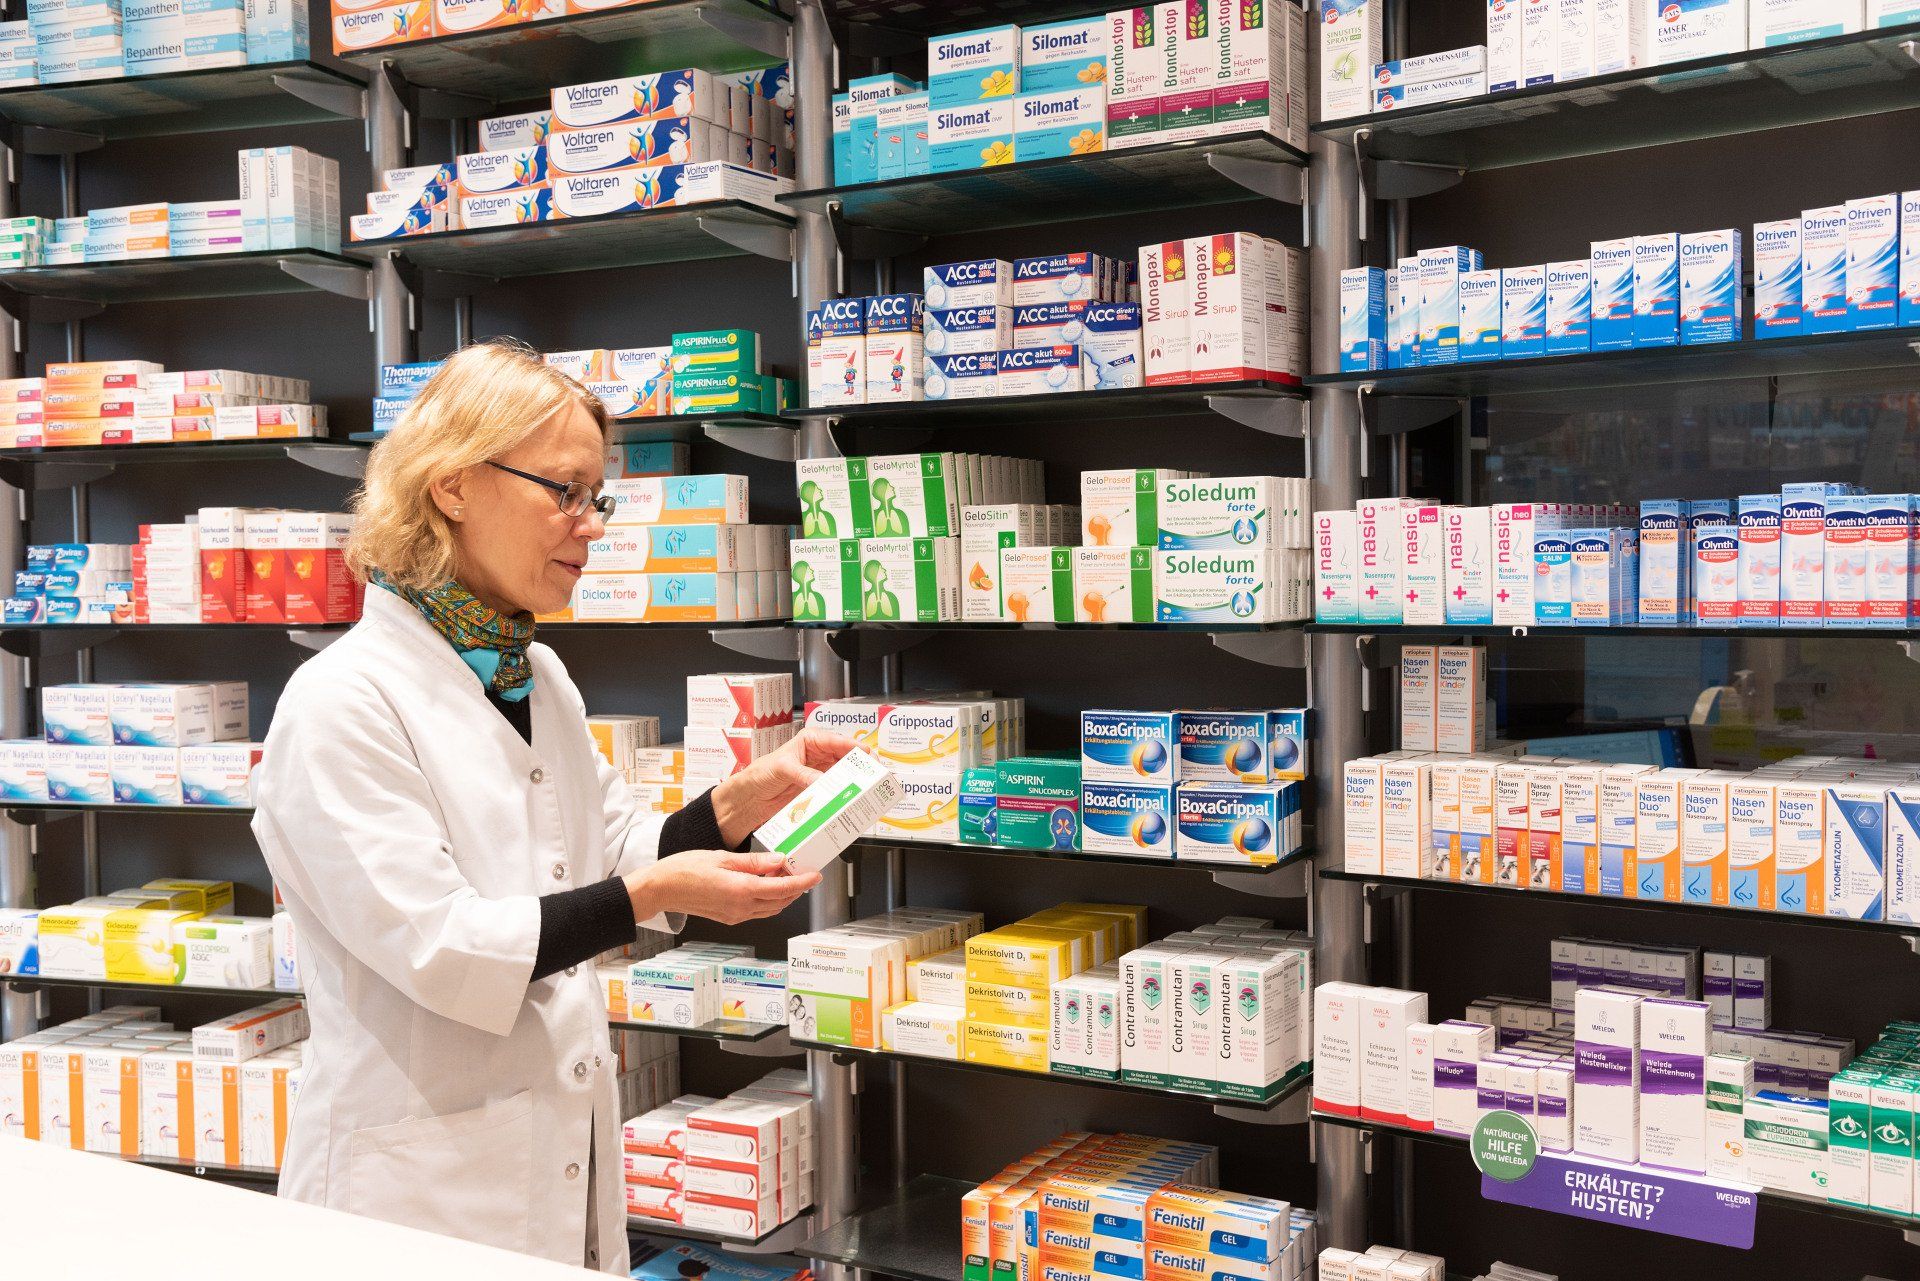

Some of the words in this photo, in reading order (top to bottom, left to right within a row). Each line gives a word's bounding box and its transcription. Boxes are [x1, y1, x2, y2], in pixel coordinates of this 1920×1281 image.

[125, 2, 179, 17] Bepanthen
[342, 12, 383, 27] Voltaren
[1490, 12, 1511, 23] EMSER
[1327, 27, 1362, 38] SINUSITIS
[1658, 25, 1687, 36] EMSER
[1032, 30, 1087, 51] Silomat
[1217, 0, 1232, 79] Bronchostop
[1327, 36, 1348, 44] SPRAY
[126, 44, 181, 59] Bepanthen
[938, 39, 991, 61] Silomat
[1164, 9, 1178, 87] Bronchostop
[1112, 18, 1125, 95] Bronchostop
[1233, 57, 1266, 67] Husten-
[1405, 58, 1425, 68] EMSER
[1428, 50, 1470, 63] NASENSALBE
[39, 62, 76, 72] Bepanthen
[1179, 66, 1211, 76] Husten-
[1233, 68, 1251, 76] saft
[1127, 74, 1157, 84] Husten-
[1180, 77, 1196, 85] saft
[566, 84, 618, 101] Voltaren
[1127, 84, 1142, 92] saft
[1024, 97, 1079, 117] Silomat
[937, 109, 990, 129] Silomat
[562, 131, 614, 148] Voltaren
[686, 163, 719, 176] Voltaren
[567, 176, 619, 192] Voltaren
[1849, 208, 1891, 220] Otriven
[90, 215, 127, 226] Bepanthen
[1756, 230, 1797, 241] Otriven
[1682, 242, 1728, 255] Otriven
[1593, 249, 1630, 260] Otriven
[1420, 257, 1454, 267] Otriven
[945, 264, 977, 281] ACC
[978, 262, 995, 270] akut
[1018, 261, 1048, 277] ACC
[1195, 245, 1210, 316] Monapax
[1147, 253, 1161, 322] Monapax
[822, 301, 857, 320] ACC
[868, 298, 905, 317] ACC
[1213, 305, 1237, 314] Sirup
[1086, 309, 1114, 323] ACC
[1165, 310, 1188, 319] Sirup
[822, 320, 859, 329] Kindersaft
[868, 317, 907, 326] Kindersaft
[682, 337, 711, 345] ASPIRIN
[618, 352, 656, 362] Voltaren
[1002, 352, 1033, 367] ACC
[384, 376, 414, 385] CLASSIC
[682, 378, 711, 387] ASPIRIN
[802, 464, 843, 475] GeloMyrtol
[873, 462, 916, 473] GeloMyrtol
[1087, 476, 1131, 485] GeloProsed
[1166, 483, 1256, 502] Soledum
[1227, 503, 1255, 511] forte
[1783, 507, 1822, 518] Olynth
[965, 511, 1008, 521] GeloSitin
[1740, 516, 1778, 527] Olynth
[1867, 517, 1898, 525] Olynth
[1642, 519, 1676, 529] Olynth
[1359, 506, 1376, 567] nasic
[866, 544, 908, 554] GeloMyrtol
[1316, 518, 1331, 570] nasic
[1166, 556, 1254, 573] Soledum
[1225, 576, 1254, 584] forte
[582, 589, 611, 599] Diclox
[613, 589, 637, 599] forte
[1404, 658, 1429, 666] Nasen
[1404, 666, 1420, 674] Duo
[73, 694, 105, 703] Nagellack
[815, 711, 875, 726] Grippostad
[889, 715, 952, 729] Grippostad
[1084, 722, 1165, 741] BoxaGrippal
[1006, 775, 1043, 785] ASPIRIN
[1029, 787, 1074, 796] SINUCOMPLEX
[1084, 793, 1164, 813] BoxaGrippal
[1686, 795, 1718, 804] Nasen
[1180, 798, 1269, 819] BoxaGrippal
[1686, 805, 1707, 814] Duo
[1896, 834, 1904, 901] XYLOMETAZOLIN
[969, 947, 1015, 960] Dekristolvit
[633, 969, 672, 979] IbuHEXAL
[1125, 964, 1135, 1047] Contramutan
[1144, 1016, 1160, 1025] Sirup
[1220, 974, 1231, 1059] Contramutan
[896, 1018, 929, 1028] Dekristol
[1323, 1035, 1348, 1045] Echinacea
[1320, 1051, 1351, 1063] Rachenspray
[1580, 1050, 1606, 1060] Weleda
[1580, 1058, 1627, 1071] Hustenelixier
[1646, 1067, 1696, 1079] Flechtenhonig
[1483, 1127, 1528, 1141] NATÜRLICHE
[1765, 1125, 1809, 1137] VISIODORON
[1767, 1134, 1806, 1145] EUPHRASIA
[1488, 1140, 1522, 1154] HILFE
[1481, 1151, 1497, 1161] VON
[1498, 1154, 1528, 1166] WELEDA
[1564, 1170, 1664, 1202] ERKÄLTET?
[1045, 1193, 1089, 1213] Fenistil
[1716, 1192, 1750, 1205] WELEDA
[1571, 1190, 1654, 1220] HUSTEN?
[965, 1216, 986, 1226] Fenistil
[1104, 1217, 1117, 1226] GEL
[1154, 1208, 1204, 1231] Fenistil
[1222, 1234, 1237, 1245] GEL
